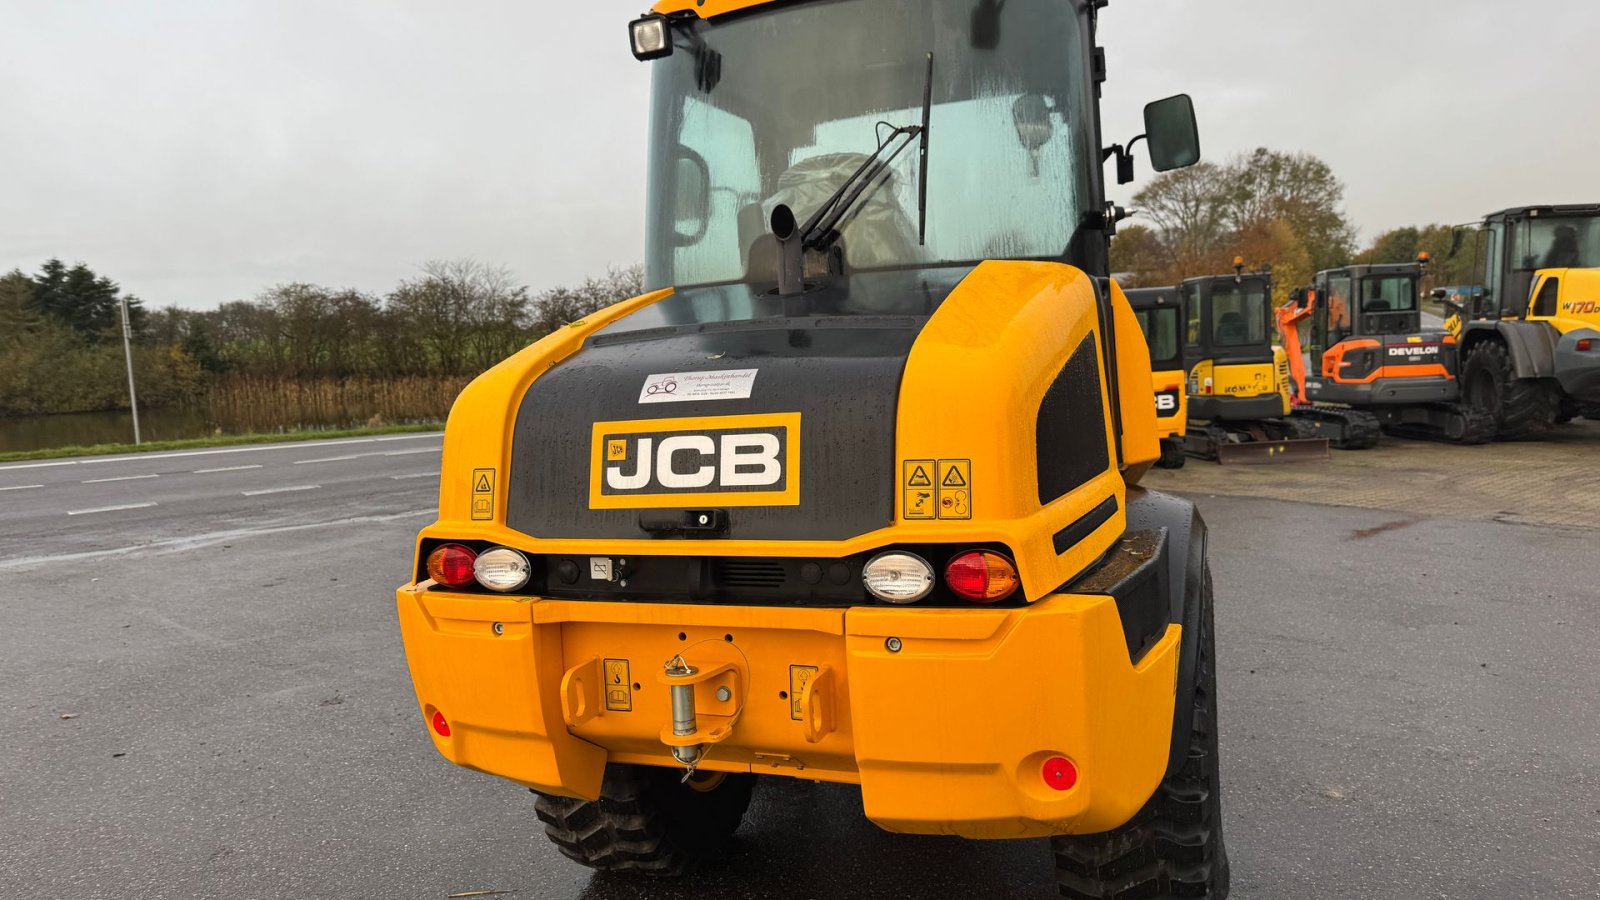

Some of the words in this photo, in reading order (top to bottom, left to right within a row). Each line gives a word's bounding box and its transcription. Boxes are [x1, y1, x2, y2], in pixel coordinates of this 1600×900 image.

[1389, 346, 1439, 356] DEVELON
[1154, 394, 1175, 410] B
[607, 433, 781, 489] JCB
